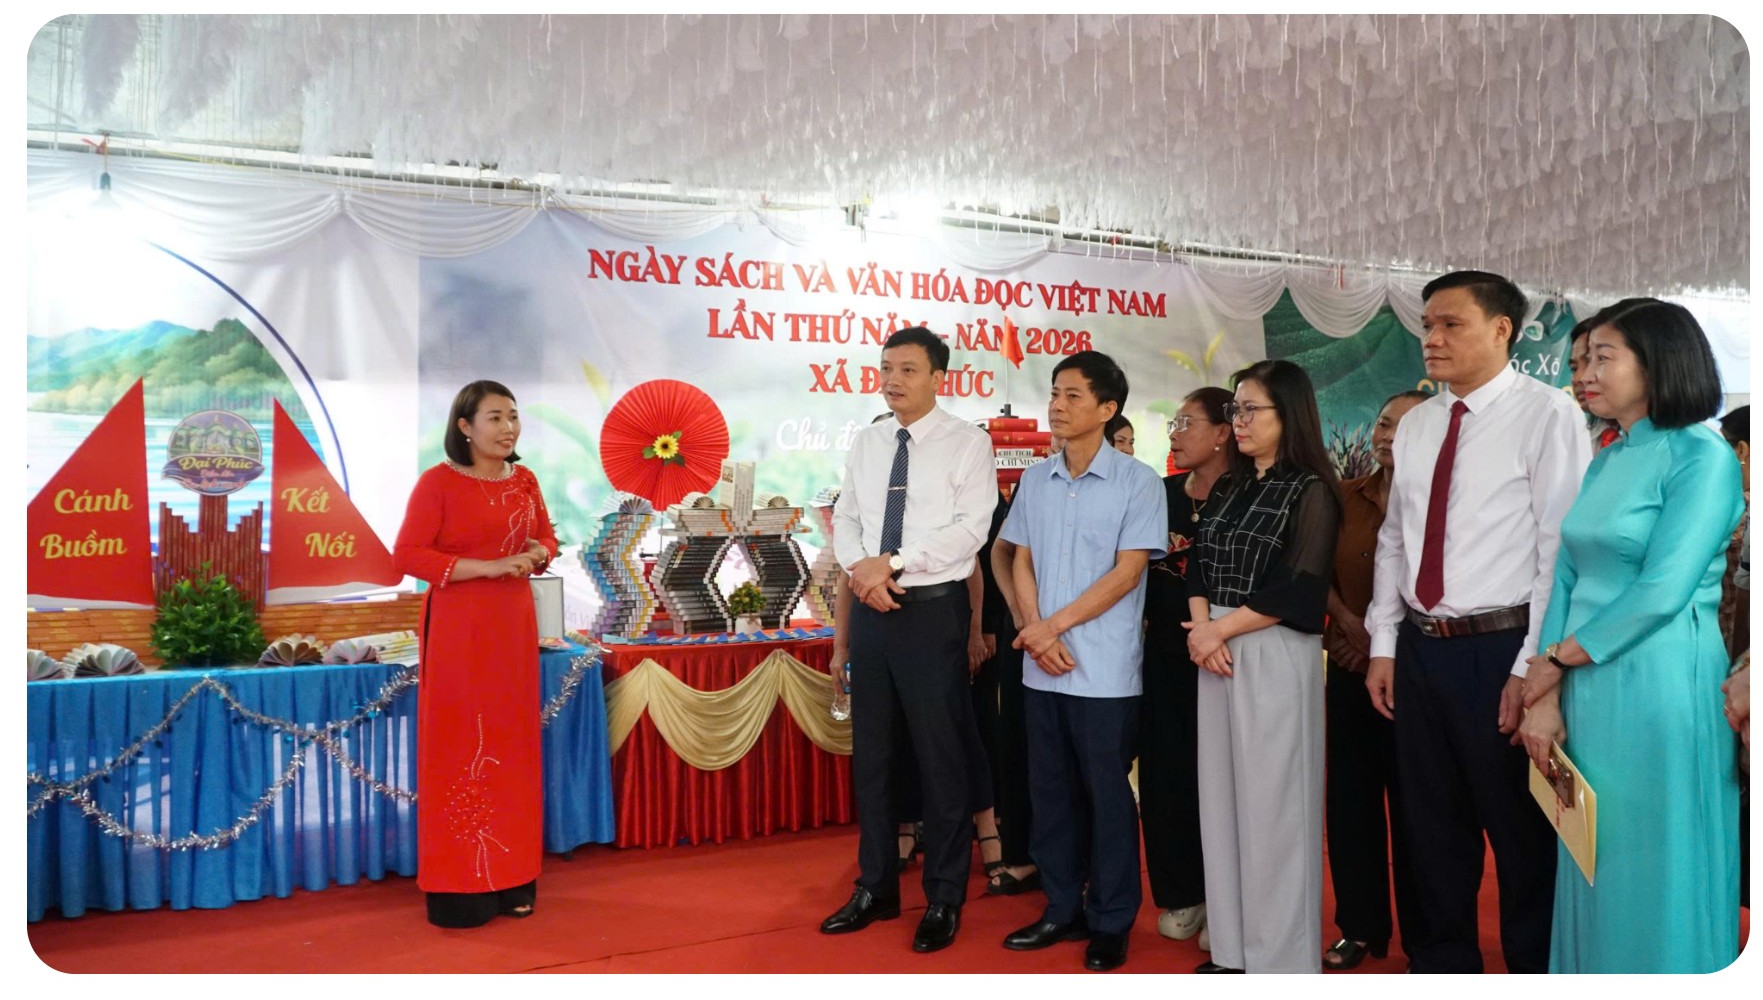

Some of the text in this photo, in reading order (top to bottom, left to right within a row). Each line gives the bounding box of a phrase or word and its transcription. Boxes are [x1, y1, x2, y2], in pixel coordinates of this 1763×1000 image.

[587, 245, 1167, 318] NGÀY SÁCH VÀ VĂN HÓA ĐỌC VIỆT NAM
[707, 298, 776, 341] LẦN
[784, 308, 856, 344] THỨ
[1025, 328, 1092, 356] 2026
[809, 358, 853, 393] XÃ
[937, 364, 994, 398] HÚC
[776, 416, 831, 451] Chủ
[54, 488, 133, 514] Cánh
[281, 486, 331, 513] Kết
[40, 529, 127, 559] Buồm
[305, 531, 357, 558] Nối
